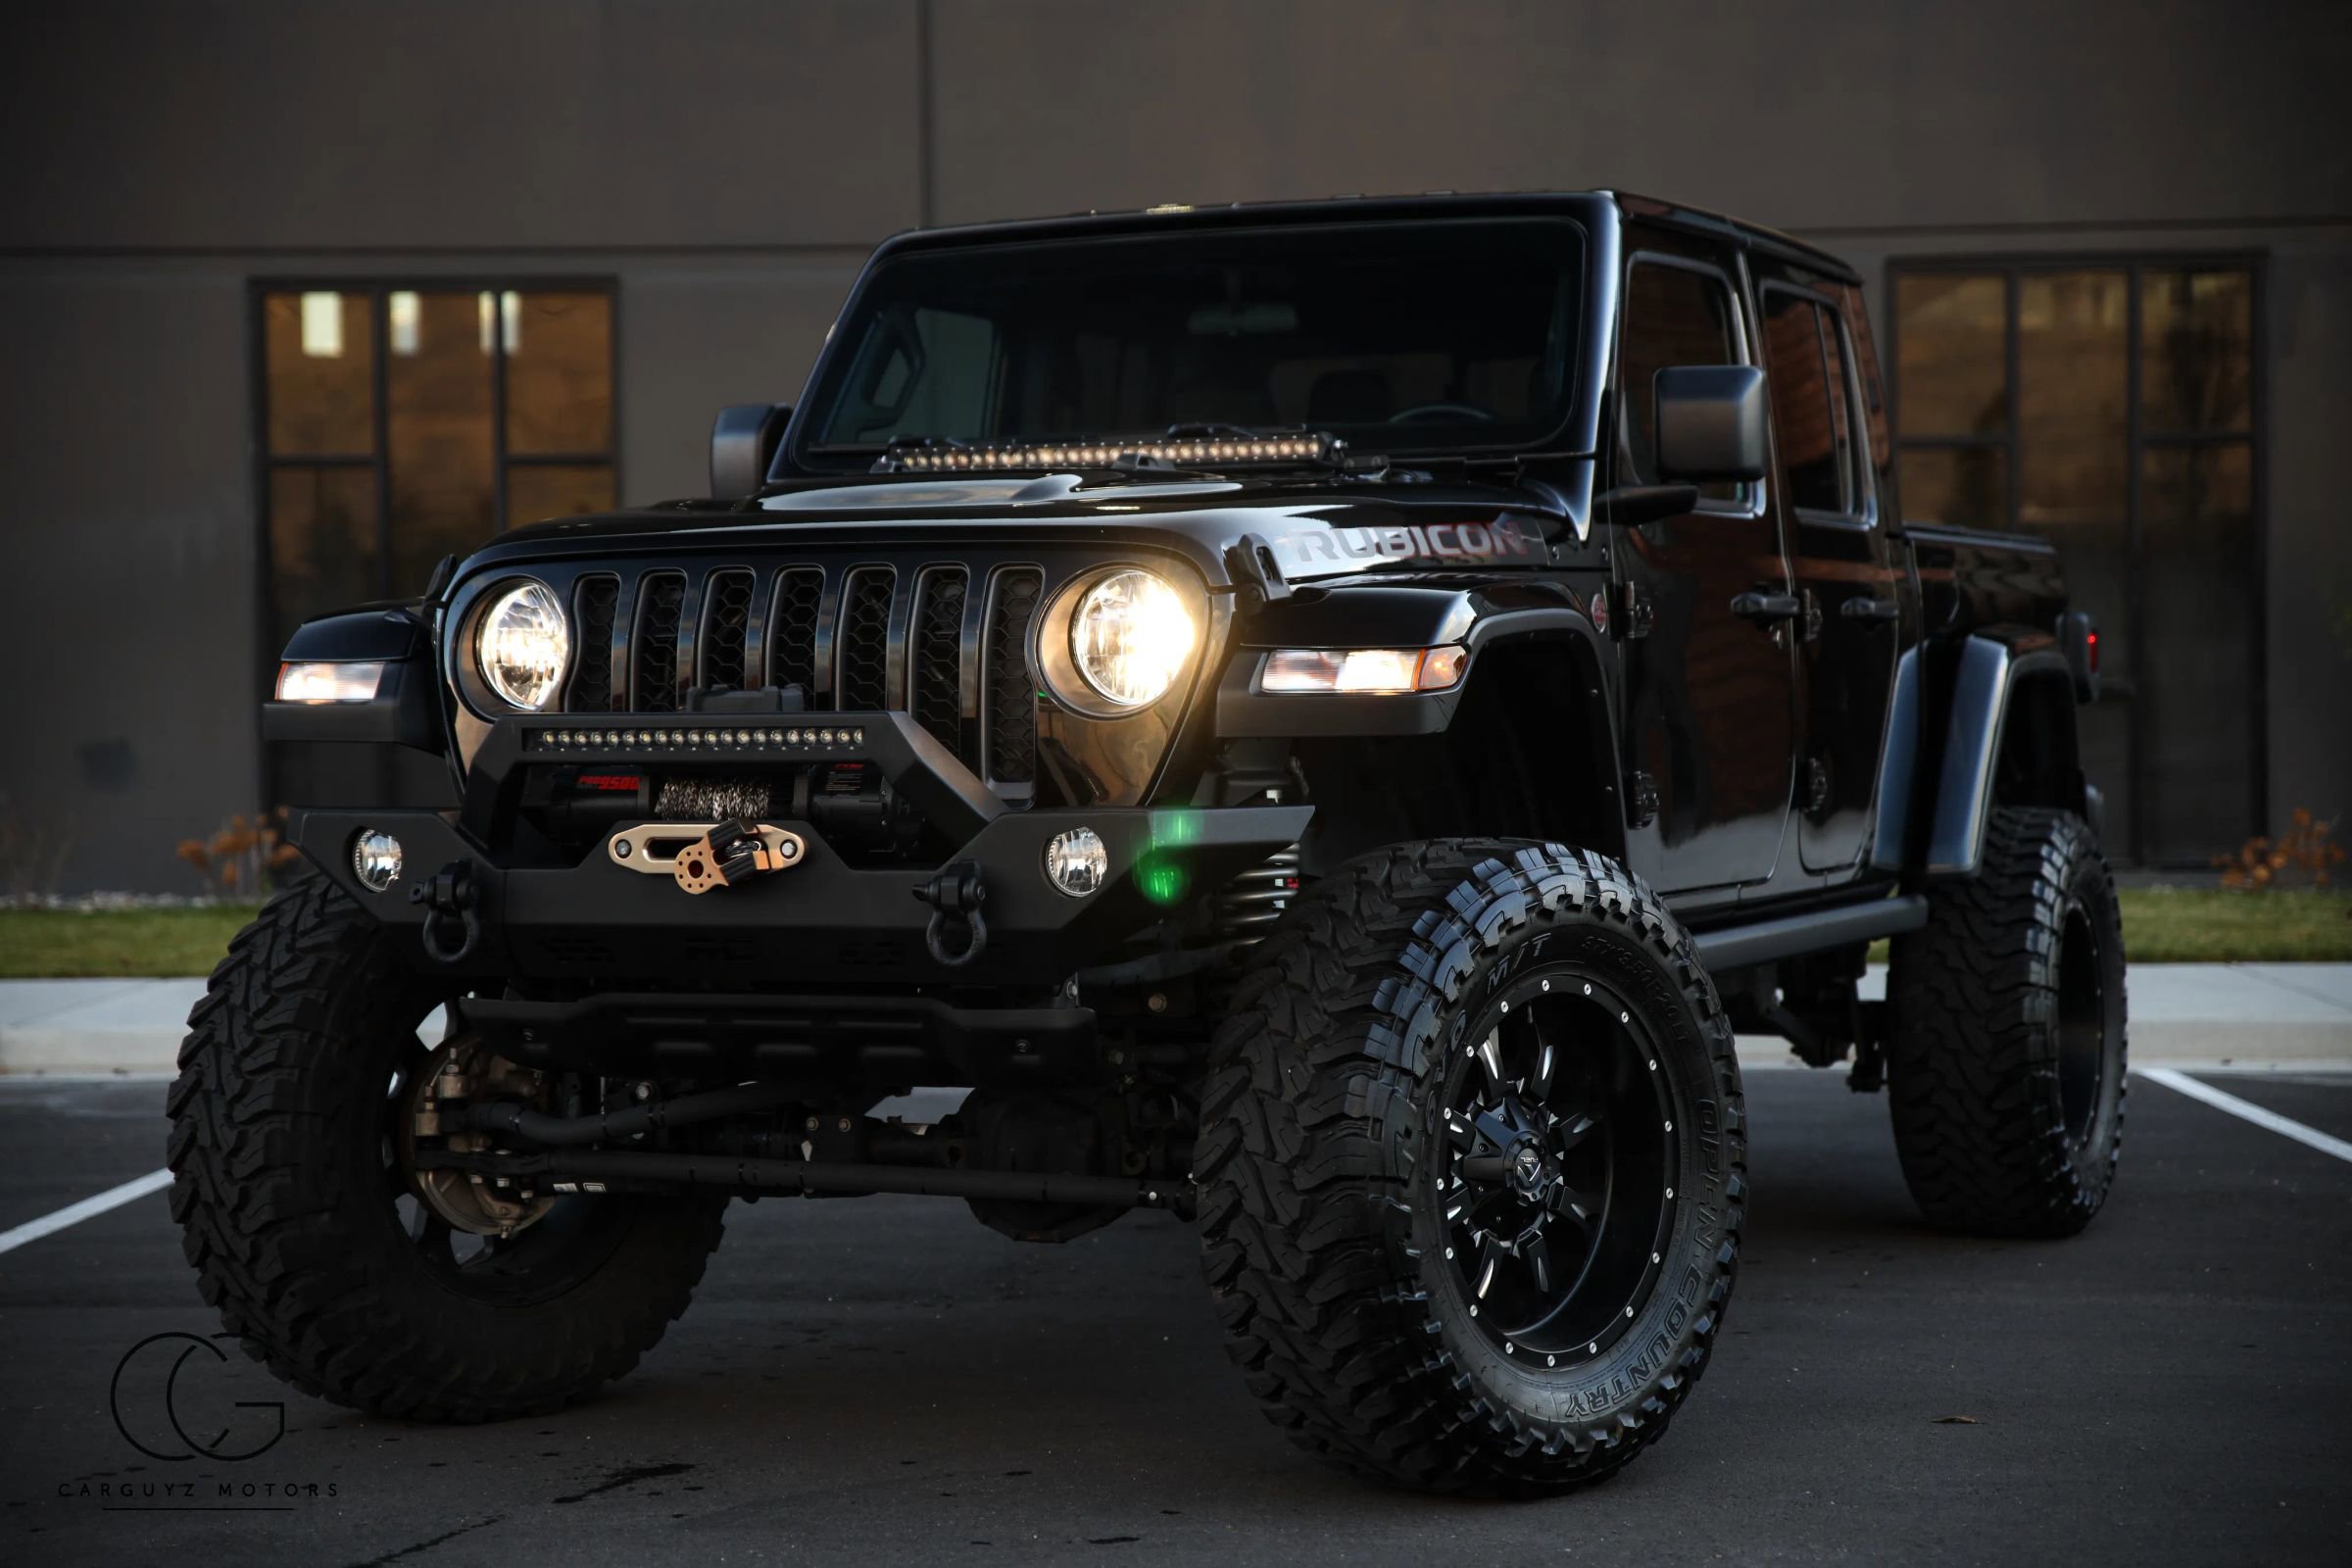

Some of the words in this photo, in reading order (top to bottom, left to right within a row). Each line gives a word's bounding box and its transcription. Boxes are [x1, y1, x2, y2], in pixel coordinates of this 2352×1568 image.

[1289, 521, 1529, 564] RUBICON
[1693, 1098, 1721, 1251] OPEN
[1565, 1262, 1703, 1417] COUNTRY
